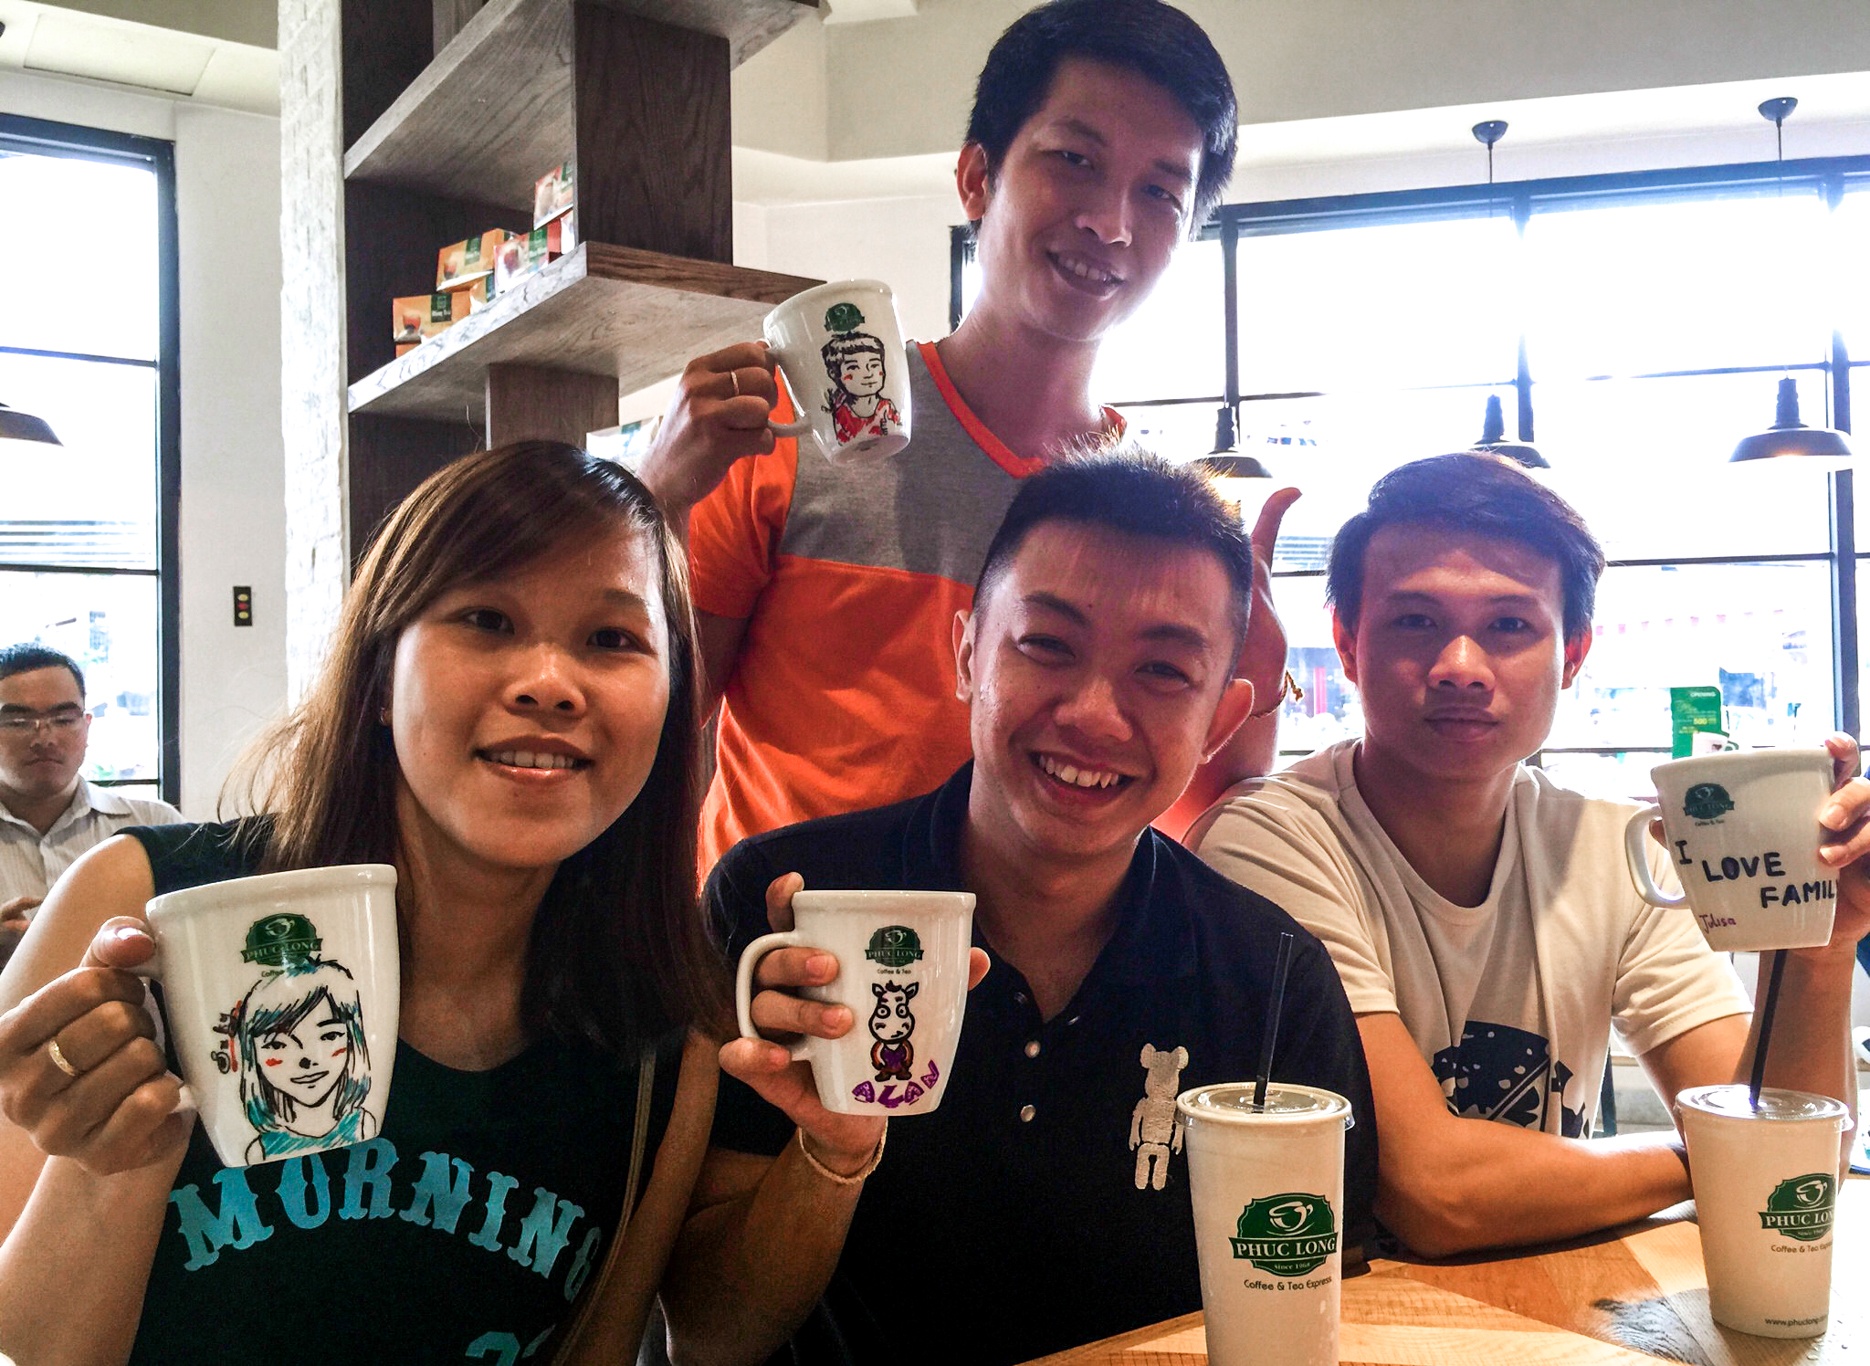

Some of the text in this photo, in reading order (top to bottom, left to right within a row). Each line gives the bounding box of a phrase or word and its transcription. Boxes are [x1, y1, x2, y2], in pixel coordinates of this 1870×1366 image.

[1675, 840, 1692, 865] I
[1702, 852, 1786, 882] LOVE
[1760, 879, 1839, 909] FAMIL
[868, 948, 921, 959] PHUC LONG
[877, 967, 894, 975] Coffee
[1765, 1214, 1811, 1227] PHUC
[1236, 1237, 1336, 1257] PHUC LONG
[1771, 1244, 1798, 1253] Coffee
[1799, 1245, 1805, 1253] &
[1807, 1244, 1819, 1252] Tea
[1243, 1276, 1332, 1291] Coffee & Tea Express
